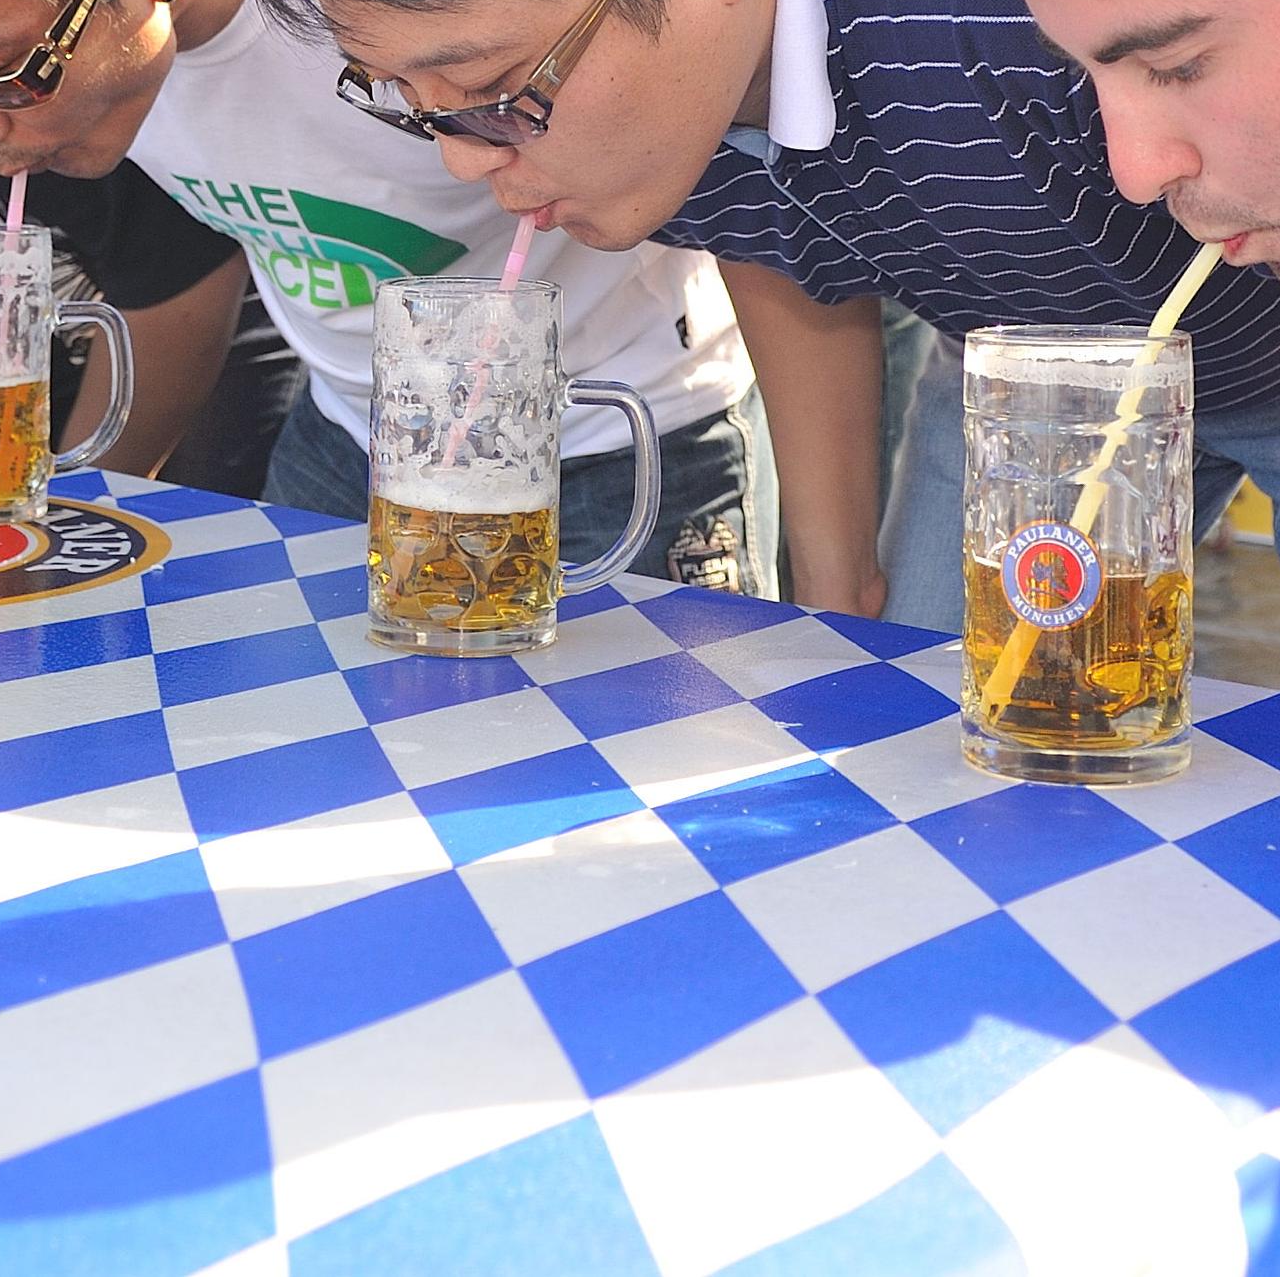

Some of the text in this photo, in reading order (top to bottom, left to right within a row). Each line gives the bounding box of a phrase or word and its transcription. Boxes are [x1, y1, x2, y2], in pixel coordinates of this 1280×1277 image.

[171, 172, 300, 229] THE
[172, 193, 321, 260] RTH
[250, 242, 343, 309] ACE
[1007, 525, 1097, 568] PAULANER
